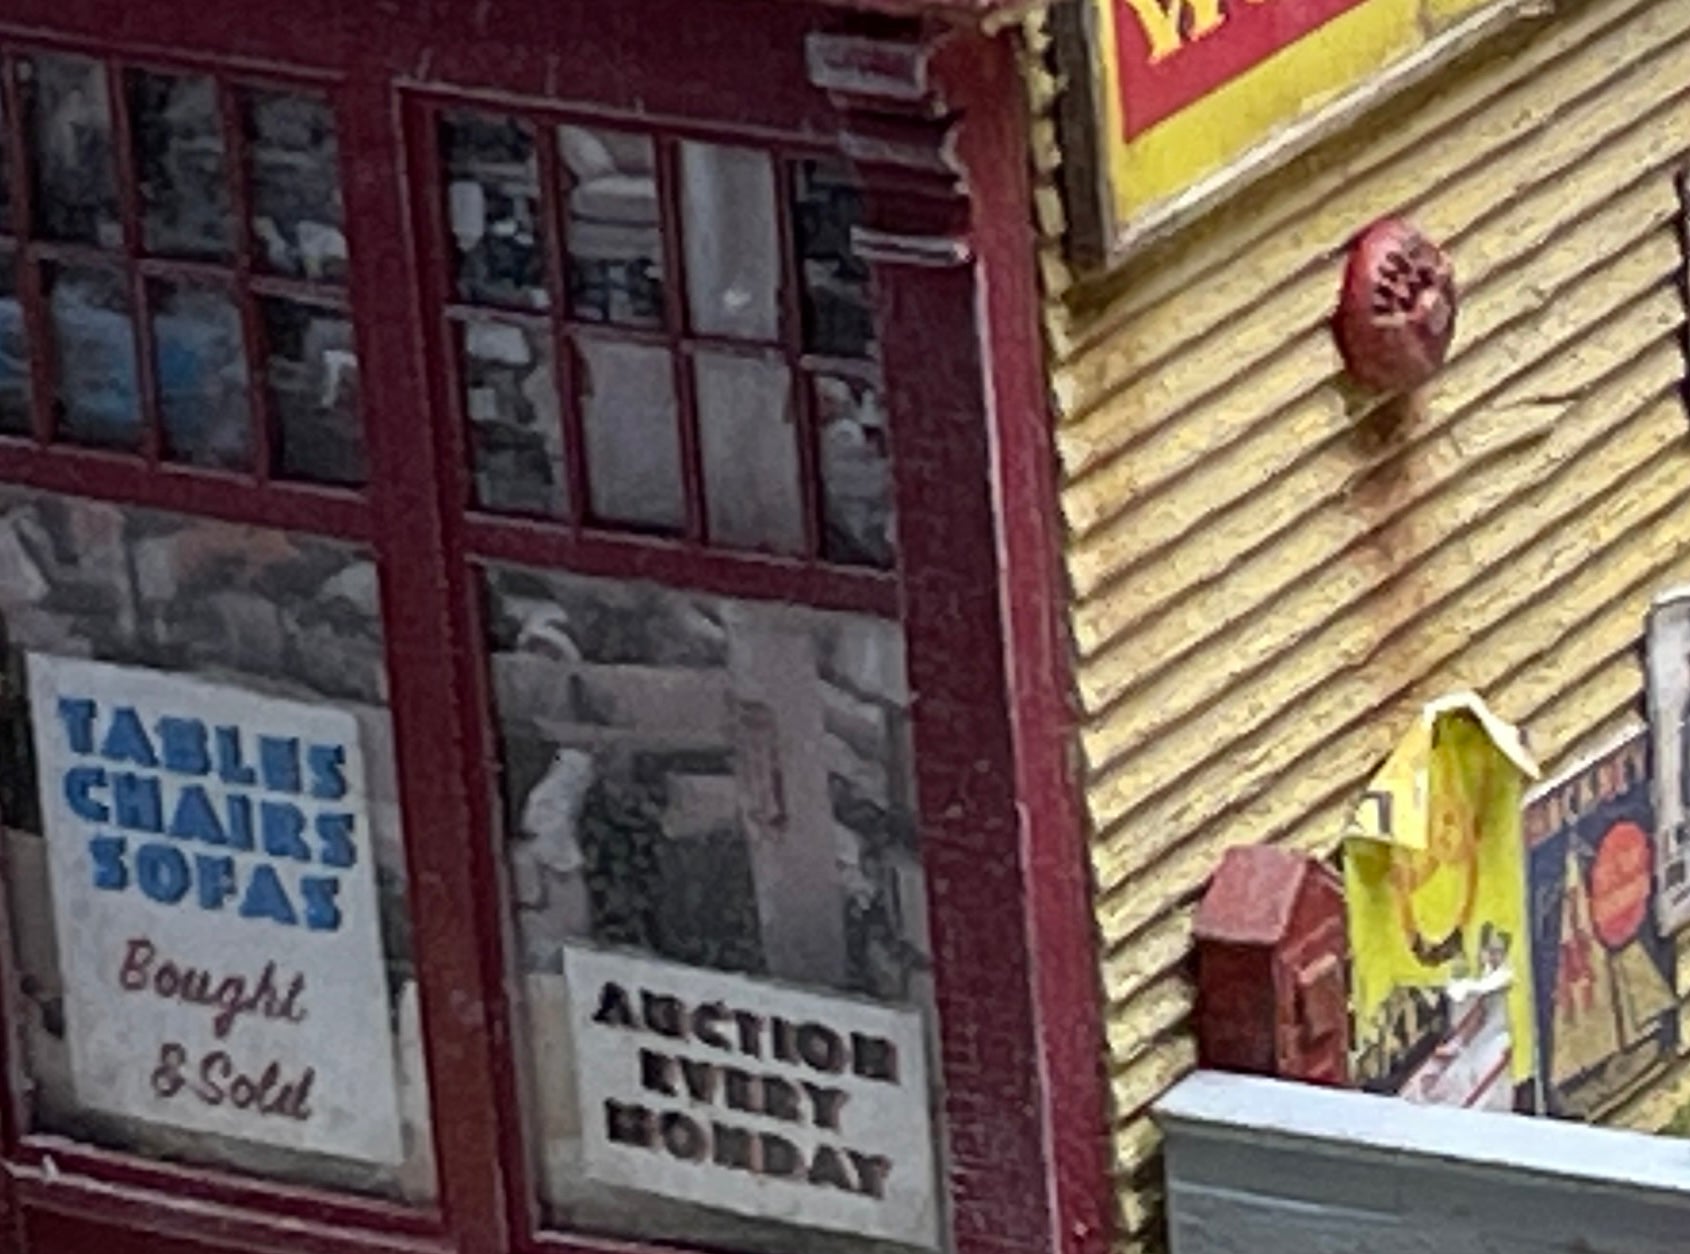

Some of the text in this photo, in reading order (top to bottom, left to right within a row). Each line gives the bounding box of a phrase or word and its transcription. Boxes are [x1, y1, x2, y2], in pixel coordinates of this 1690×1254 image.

[57, 695, 346, 800] TABLES
[64, 767, 357, 868] CHAIRS
[89, 834, 340, 931] SOFAS
[118, 938, 309, 1039] Bought
[593, 981, 899, 1085] AUCTION
[197, 1050, 314, 1122] Sold
[638, 1047, 848, 1129] EVERY
[604, 1098, 892, 1200] MONDAY
